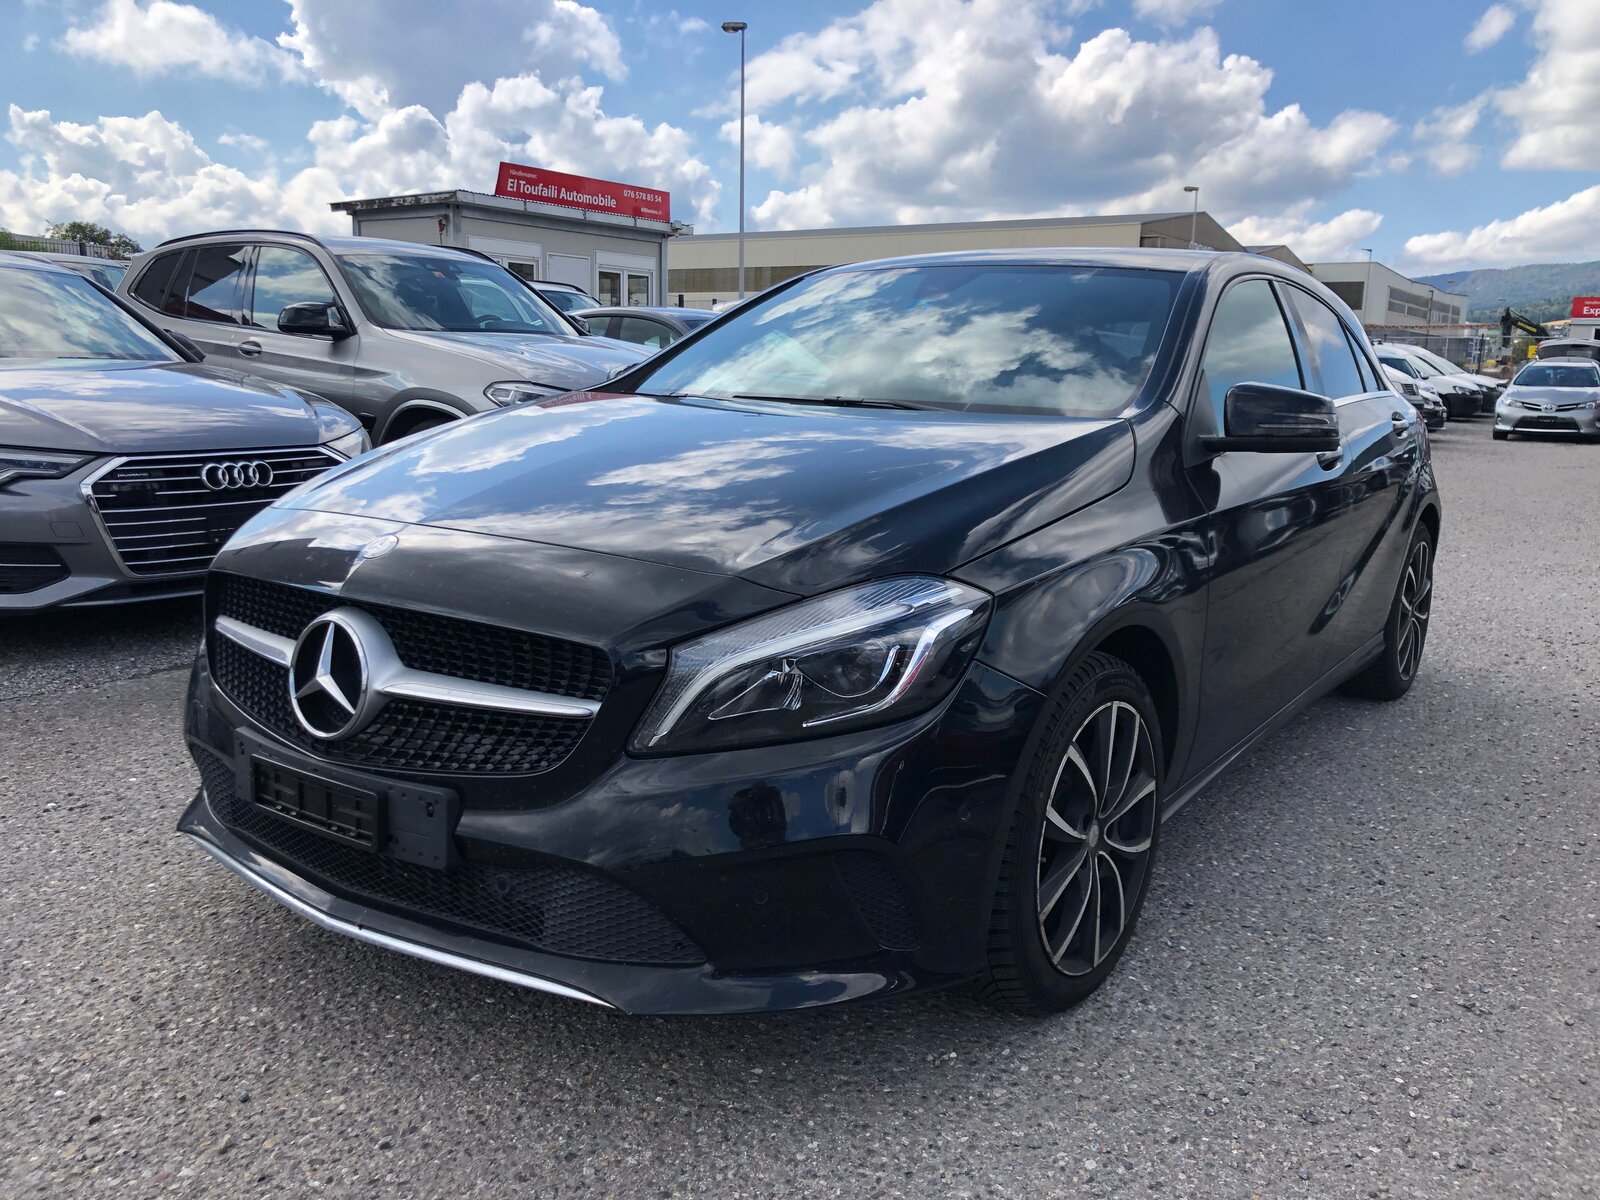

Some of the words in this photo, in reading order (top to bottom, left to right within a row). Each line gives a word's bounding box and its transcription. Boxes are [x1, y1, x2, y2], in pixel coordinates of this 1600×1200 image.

[507, 178, 518, 192] El
[519, 180, 558, 199] Toufaili
[559, 187, 616, 208] Automobile
[623, 189, 635, 198] 076
[635, 191, 646, 200] 578
[646, 193, 654, 202] 85
[655, 195, 662, 203] 54
